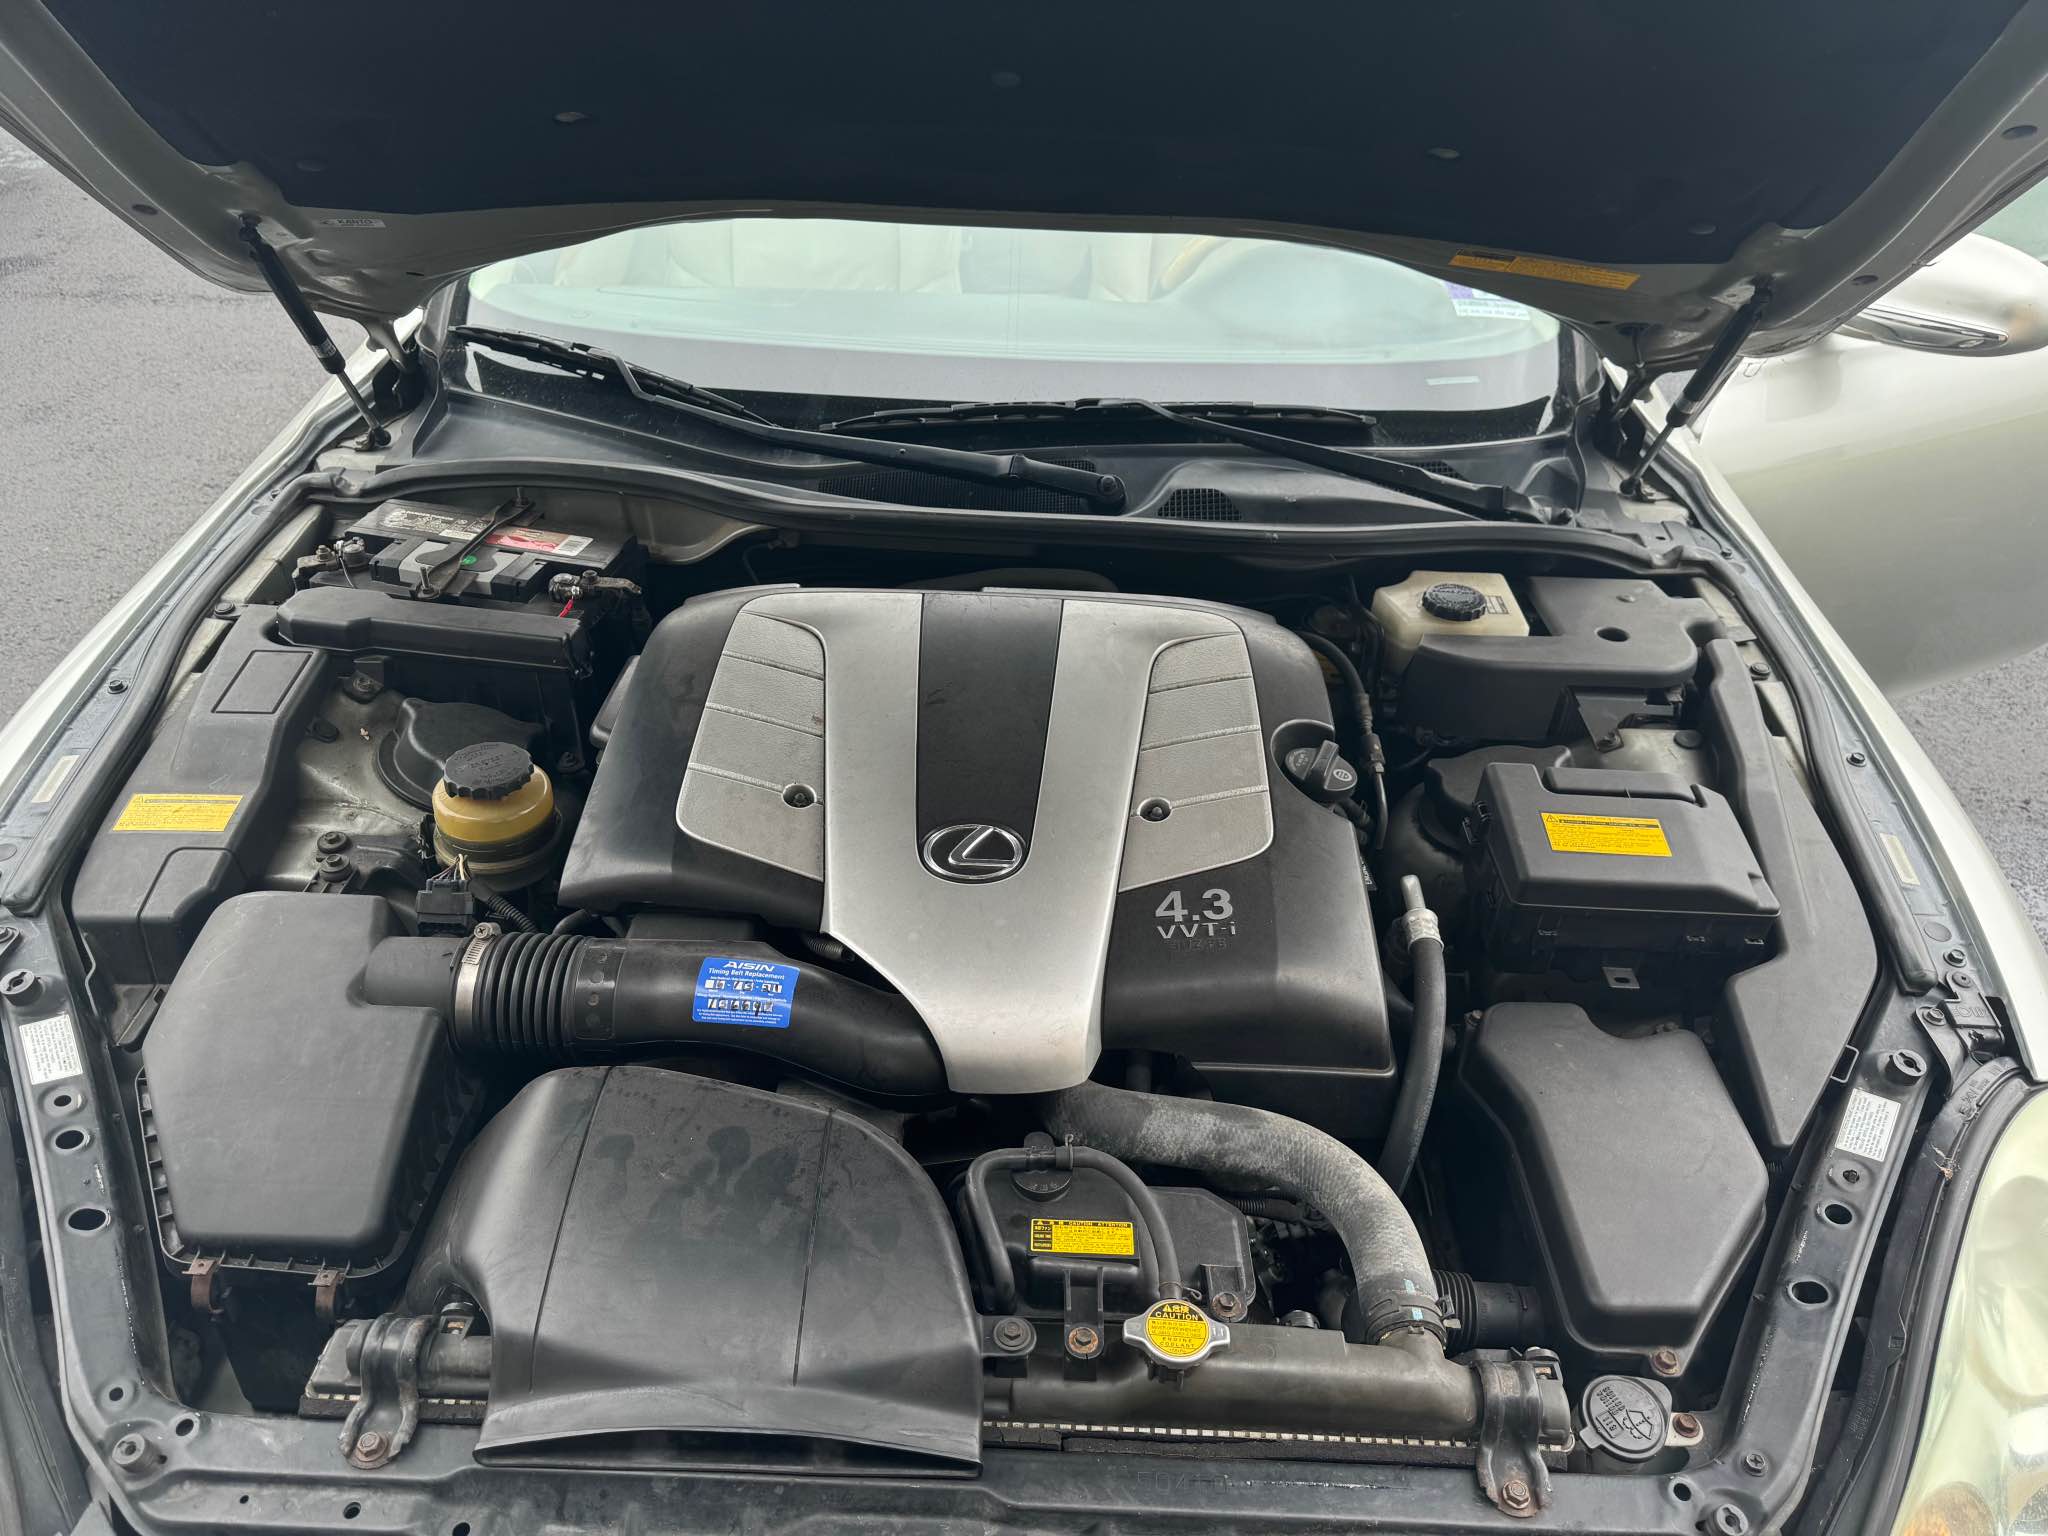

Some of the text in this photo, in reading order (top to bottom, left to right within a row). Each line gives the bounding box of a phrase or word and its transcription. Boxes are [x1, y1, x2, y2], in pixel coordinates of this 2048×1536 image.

[1155, 888, 1233, 922] 4.3
[1156, 921, 1236, 939] VVT-i
[723, 961, 775, 972] AISIN
[708, 967, 730, 977] Timing
[731, 969, 744, 977] Belt
[744, 971, 785, 980] Replacement
[1155, 1311, 1199, 1321] CAUTION
[1162, 1336, 1193, 1344] ENGINE
